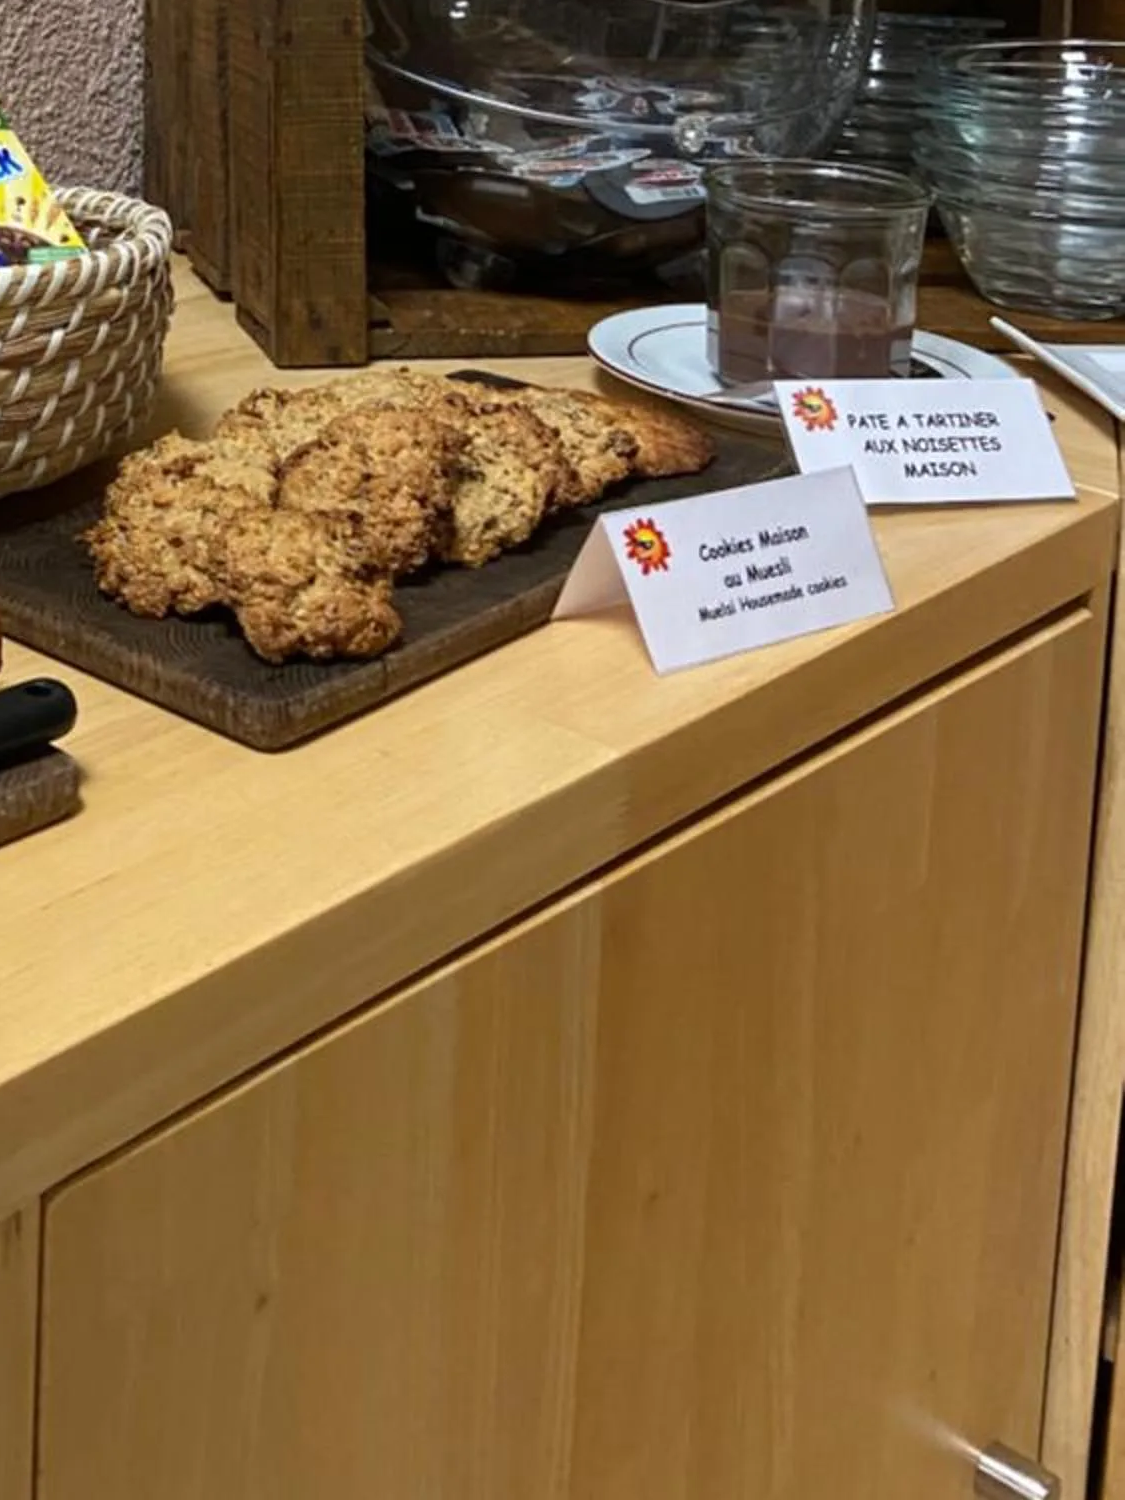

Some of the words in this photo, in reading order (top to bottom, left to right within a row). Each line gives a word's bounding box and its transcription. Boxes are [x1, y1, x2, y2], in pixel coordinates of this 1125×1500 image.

[846, 413, 890, 430] PATE
[897, 414, 909, 429] A
[912, 411, 1000, 429] TARTINER
[863, 438, 898, 454] AUX
[901, 436, 1002, 453] NOISETTES
[903, 461, 977, 479] MAISON
[698, 537, 754, 561] Cookies
[758, 525, 810, 548] Maison
[724, 573, 743, 588] au
[746, 556, 792, 583] Muesli
[806, 575, 848, 596] cookies
